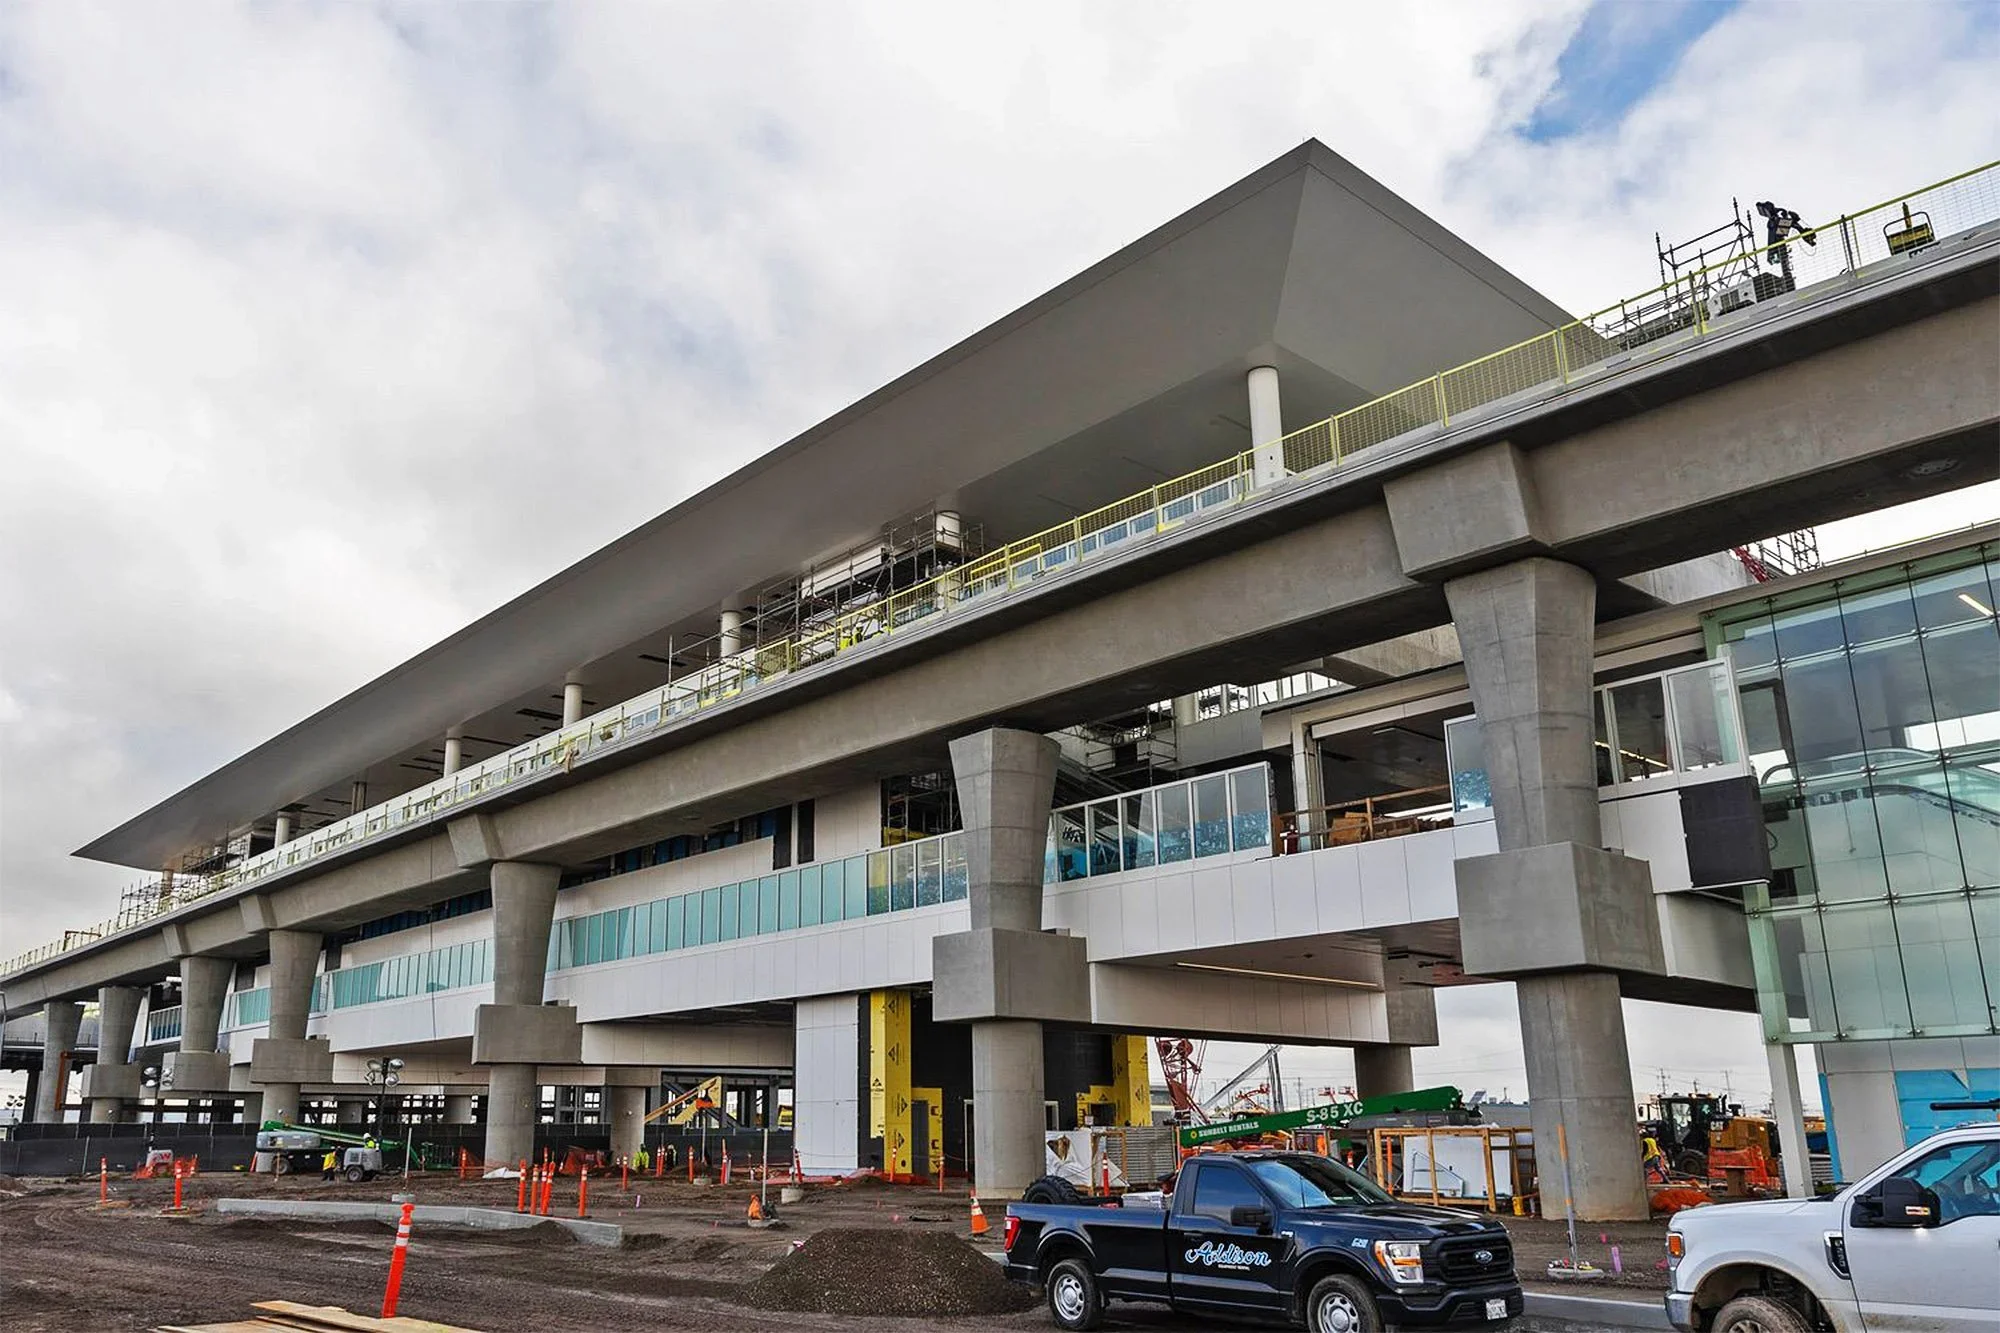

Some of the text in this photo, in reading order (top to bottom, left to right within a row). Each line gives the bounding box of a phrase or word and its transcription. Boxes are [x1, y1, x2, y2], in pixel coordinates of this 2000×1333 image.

[1306, 1101, 1364, 1123] S-85 XC
[1229, 1121, 1260, 1133] RENTALS
[1185, 1241, 1272, 1266] Addison
